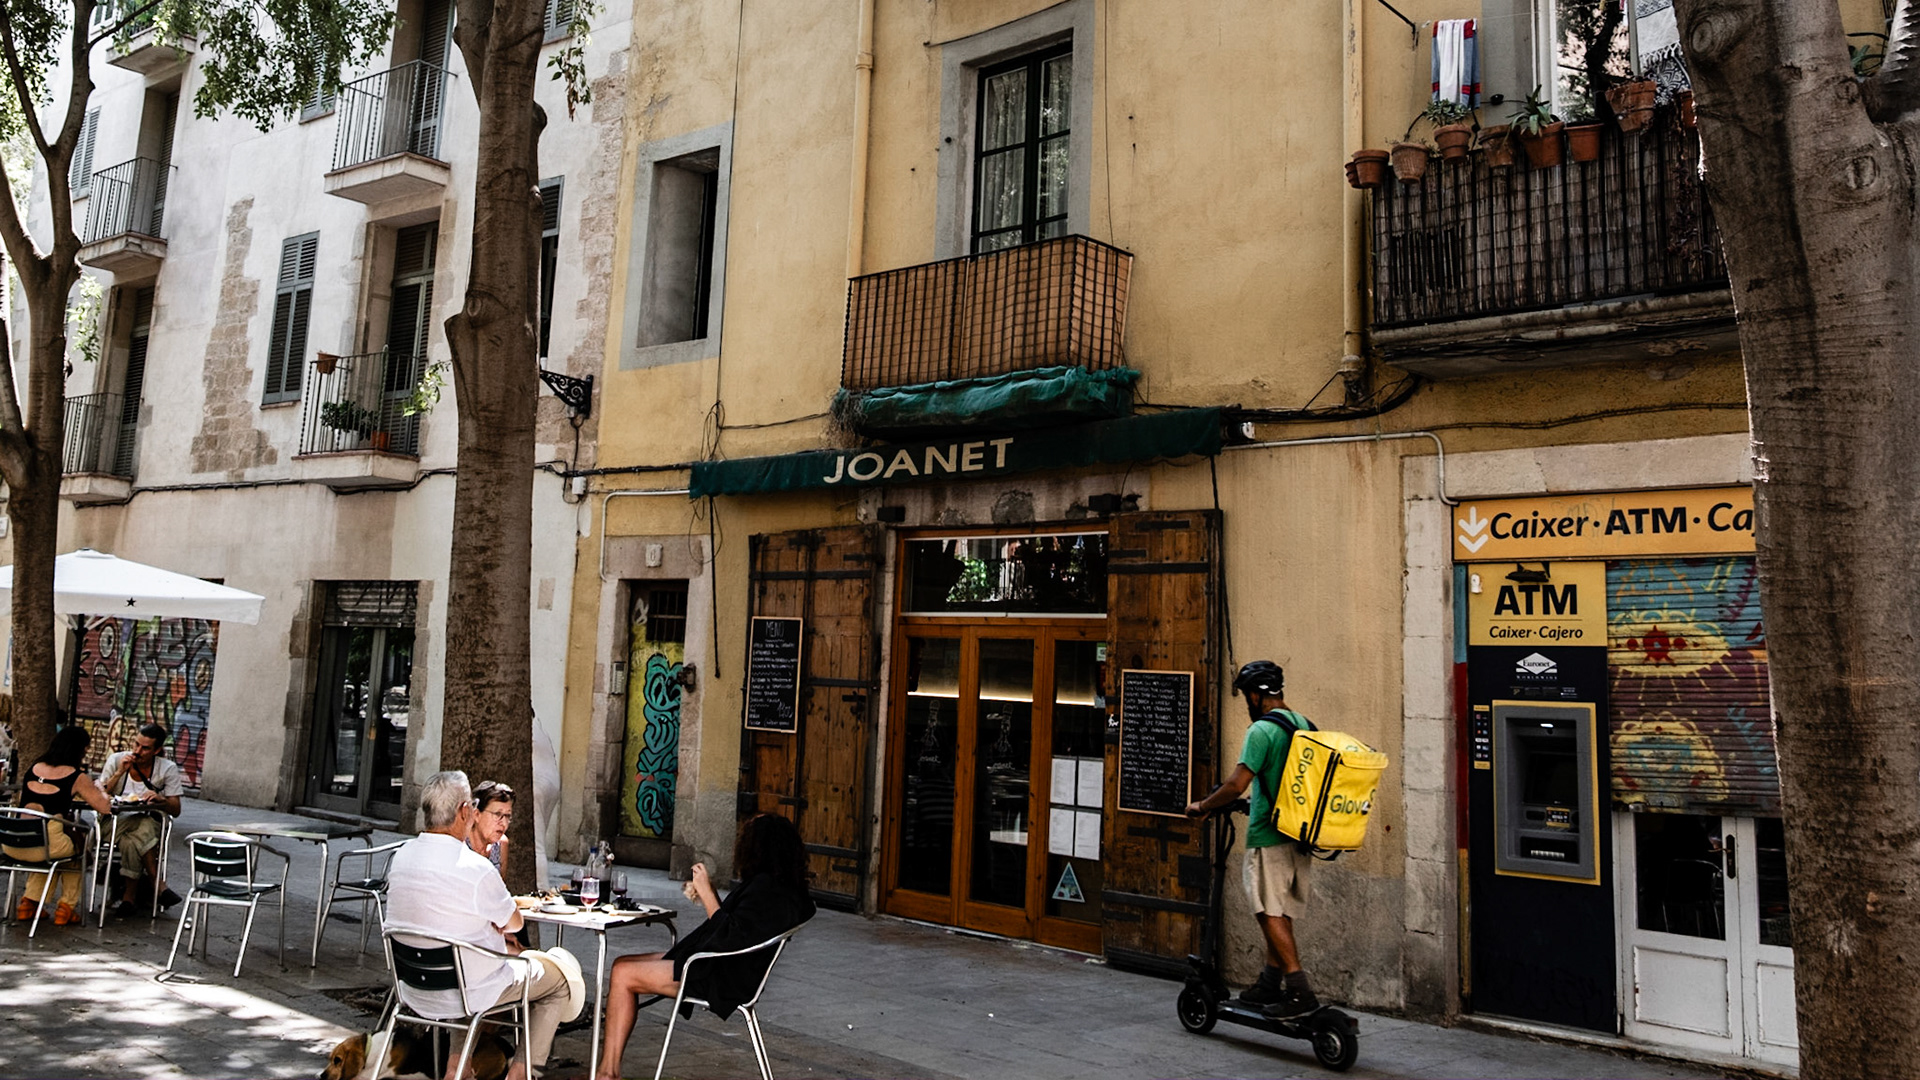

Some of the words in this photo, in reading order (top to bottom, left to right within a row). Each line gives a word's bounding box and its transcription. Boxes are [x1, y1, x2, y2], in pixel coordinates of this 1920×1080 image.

[823, 437, 1014, 484] JOANET
[1490, 511, 1589, 540] Caixer
[1604, 507, 1687, 535] ATM
[1707, 502, 1755, 538] Ca
[1494, 584, 1578, 616] ATM
[1489, 625, 1532, 639] Caixer
[1538, 625, 1583, 640] Cajero
[1522, 659, 1550, 668] Euronet
[1291, 747, 1314, 795] Glovo
